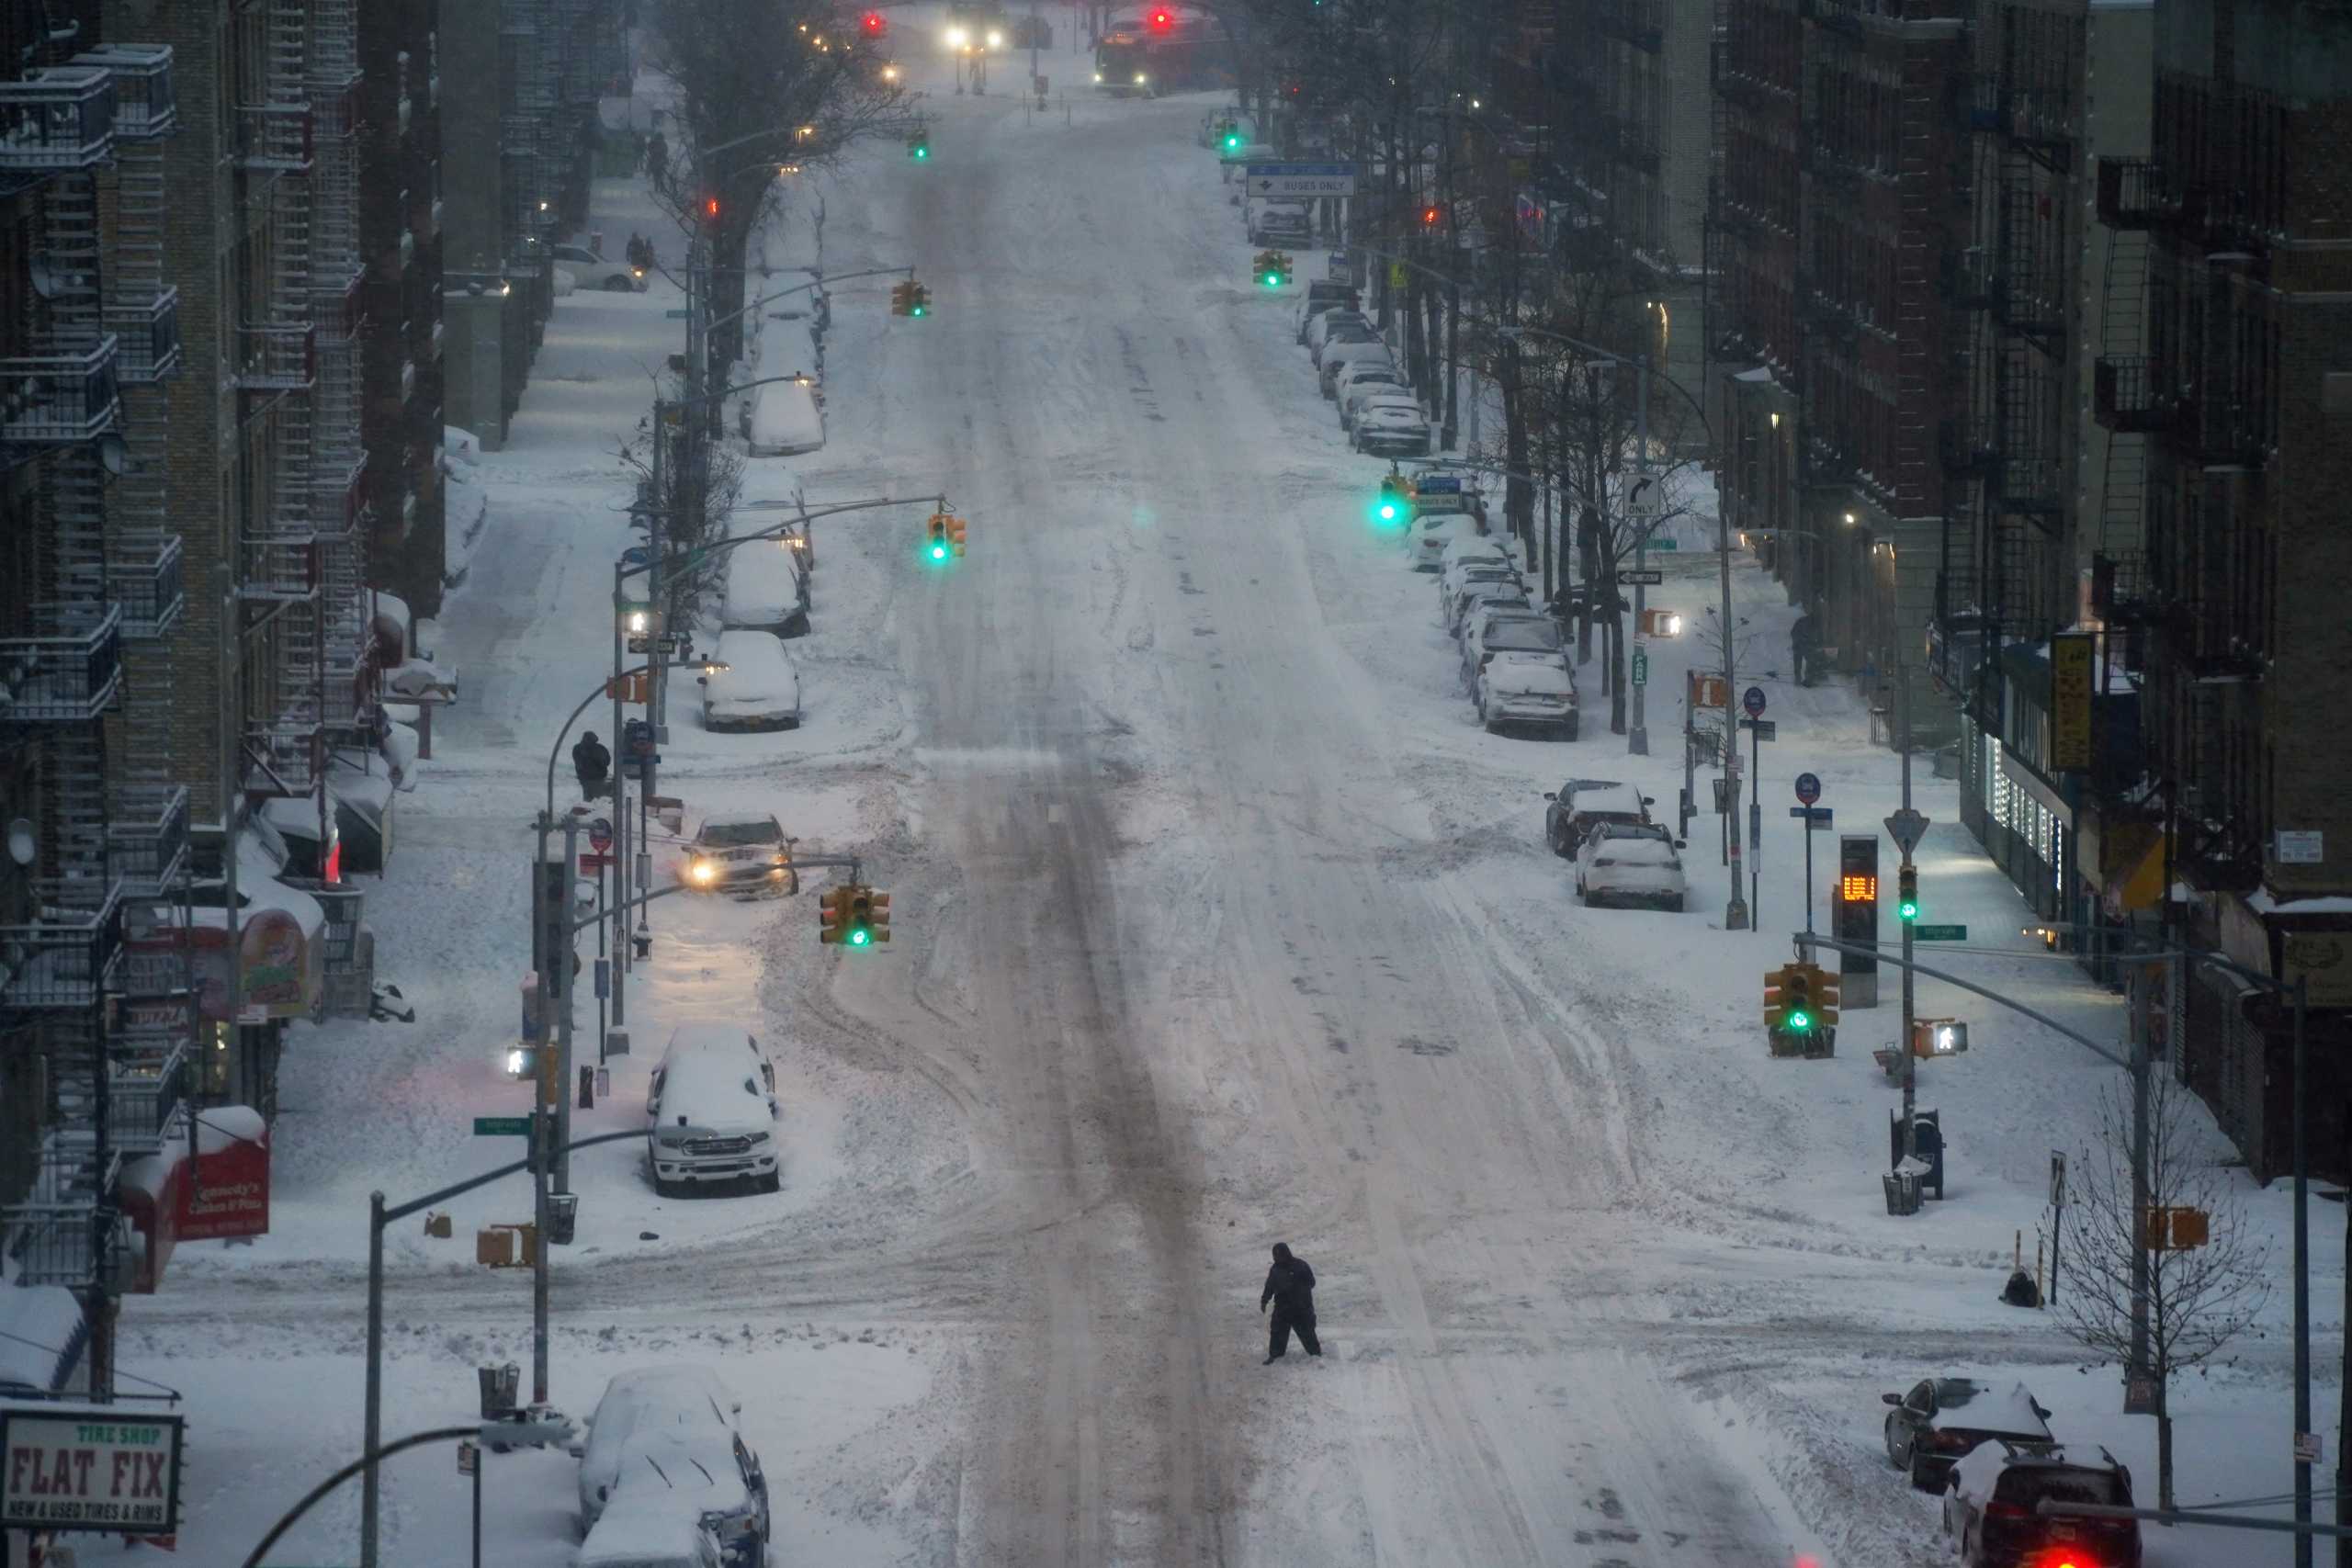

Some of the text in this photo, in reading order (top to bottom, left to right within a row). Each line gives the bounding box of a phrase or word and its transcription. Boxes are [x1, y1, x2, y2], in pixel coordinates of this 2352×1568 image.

[1319, 182, 1345, 191] ONLY
[1629, 505, 1655, 514] ONLY
[1635, 655, 1644, 680] PARK
[77, 1425, 162, 1445] TIRE SHOP
[11, 1448, 165, 1498] FLAT FIX
[7, 1500, 36, 1518] NEW
[39, 1502, 47, 1518] &
[50, 1502, 81, 1519] USED
[84, 1503, 119, 1520] TIRES
[132, 1505, 164, 1522] RIMS
